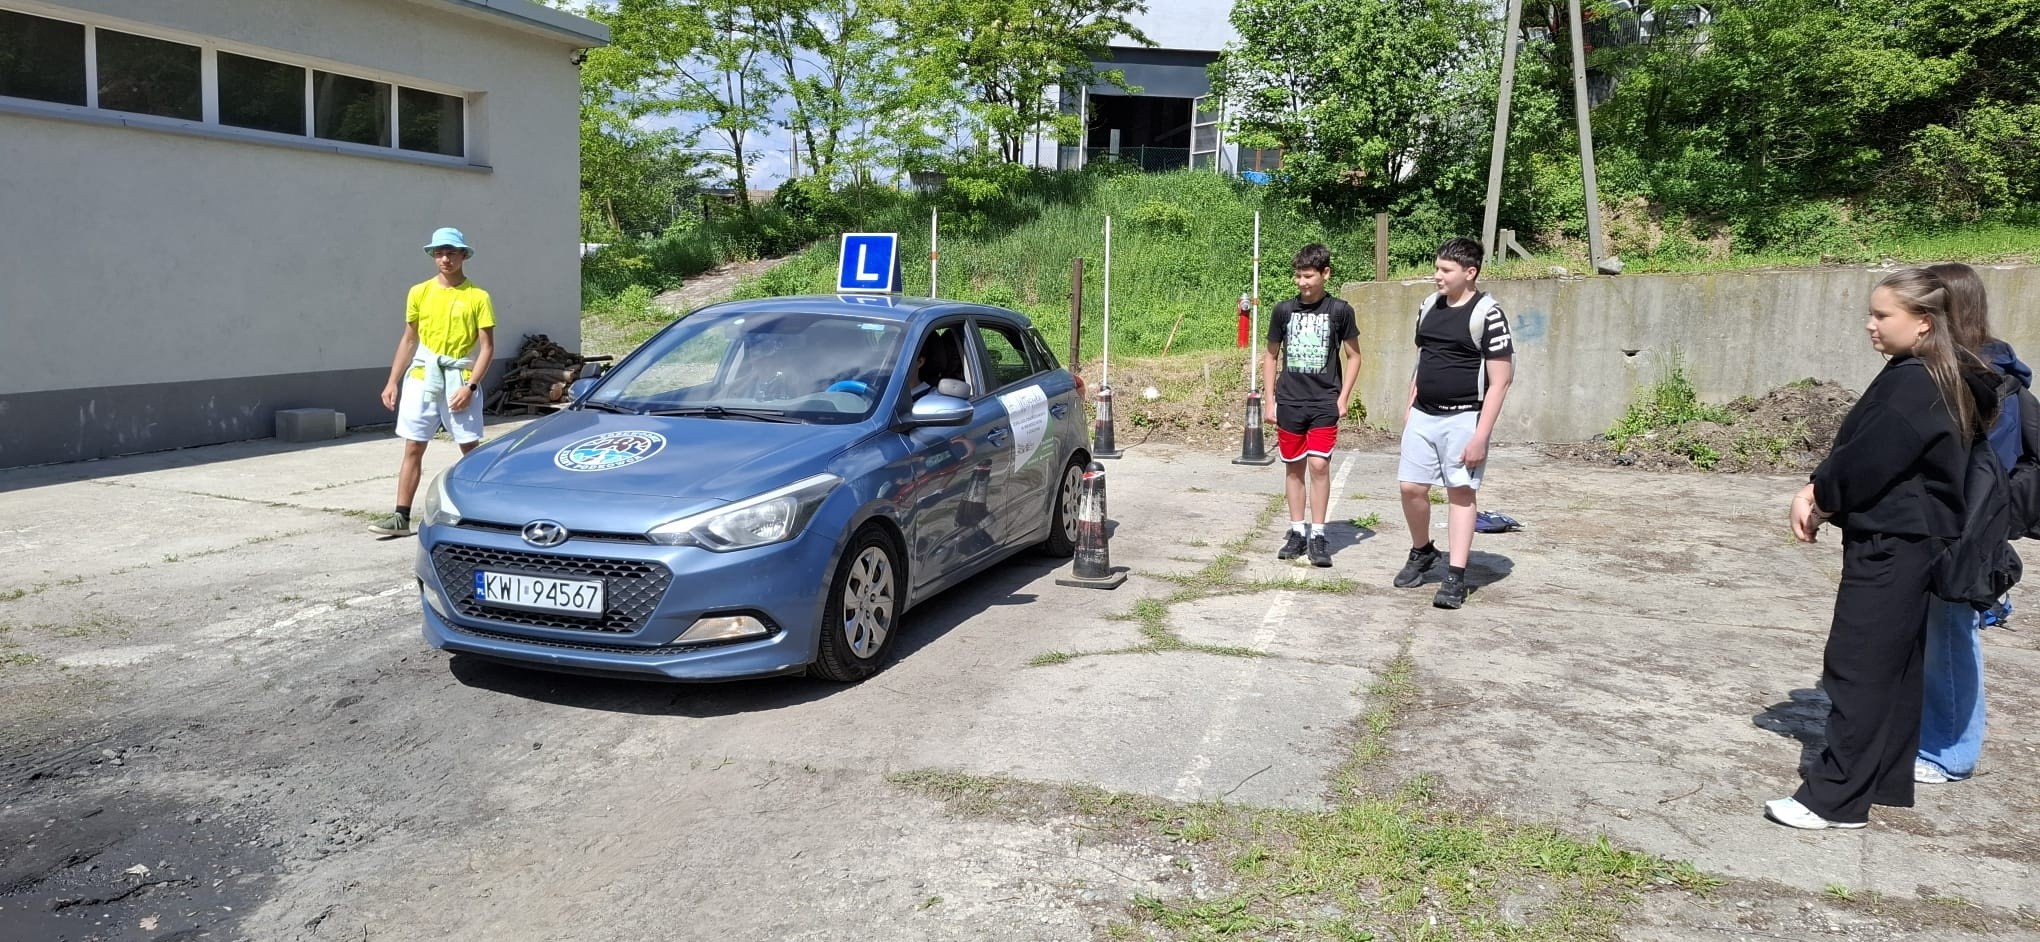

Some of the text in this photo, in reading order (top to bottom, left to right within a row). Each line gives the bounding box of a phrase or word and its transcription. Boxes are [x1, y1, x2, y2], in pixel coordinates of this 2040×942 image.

[856, 243, 879, 281] L
[486, 574, 599, 610] KWI 94567
